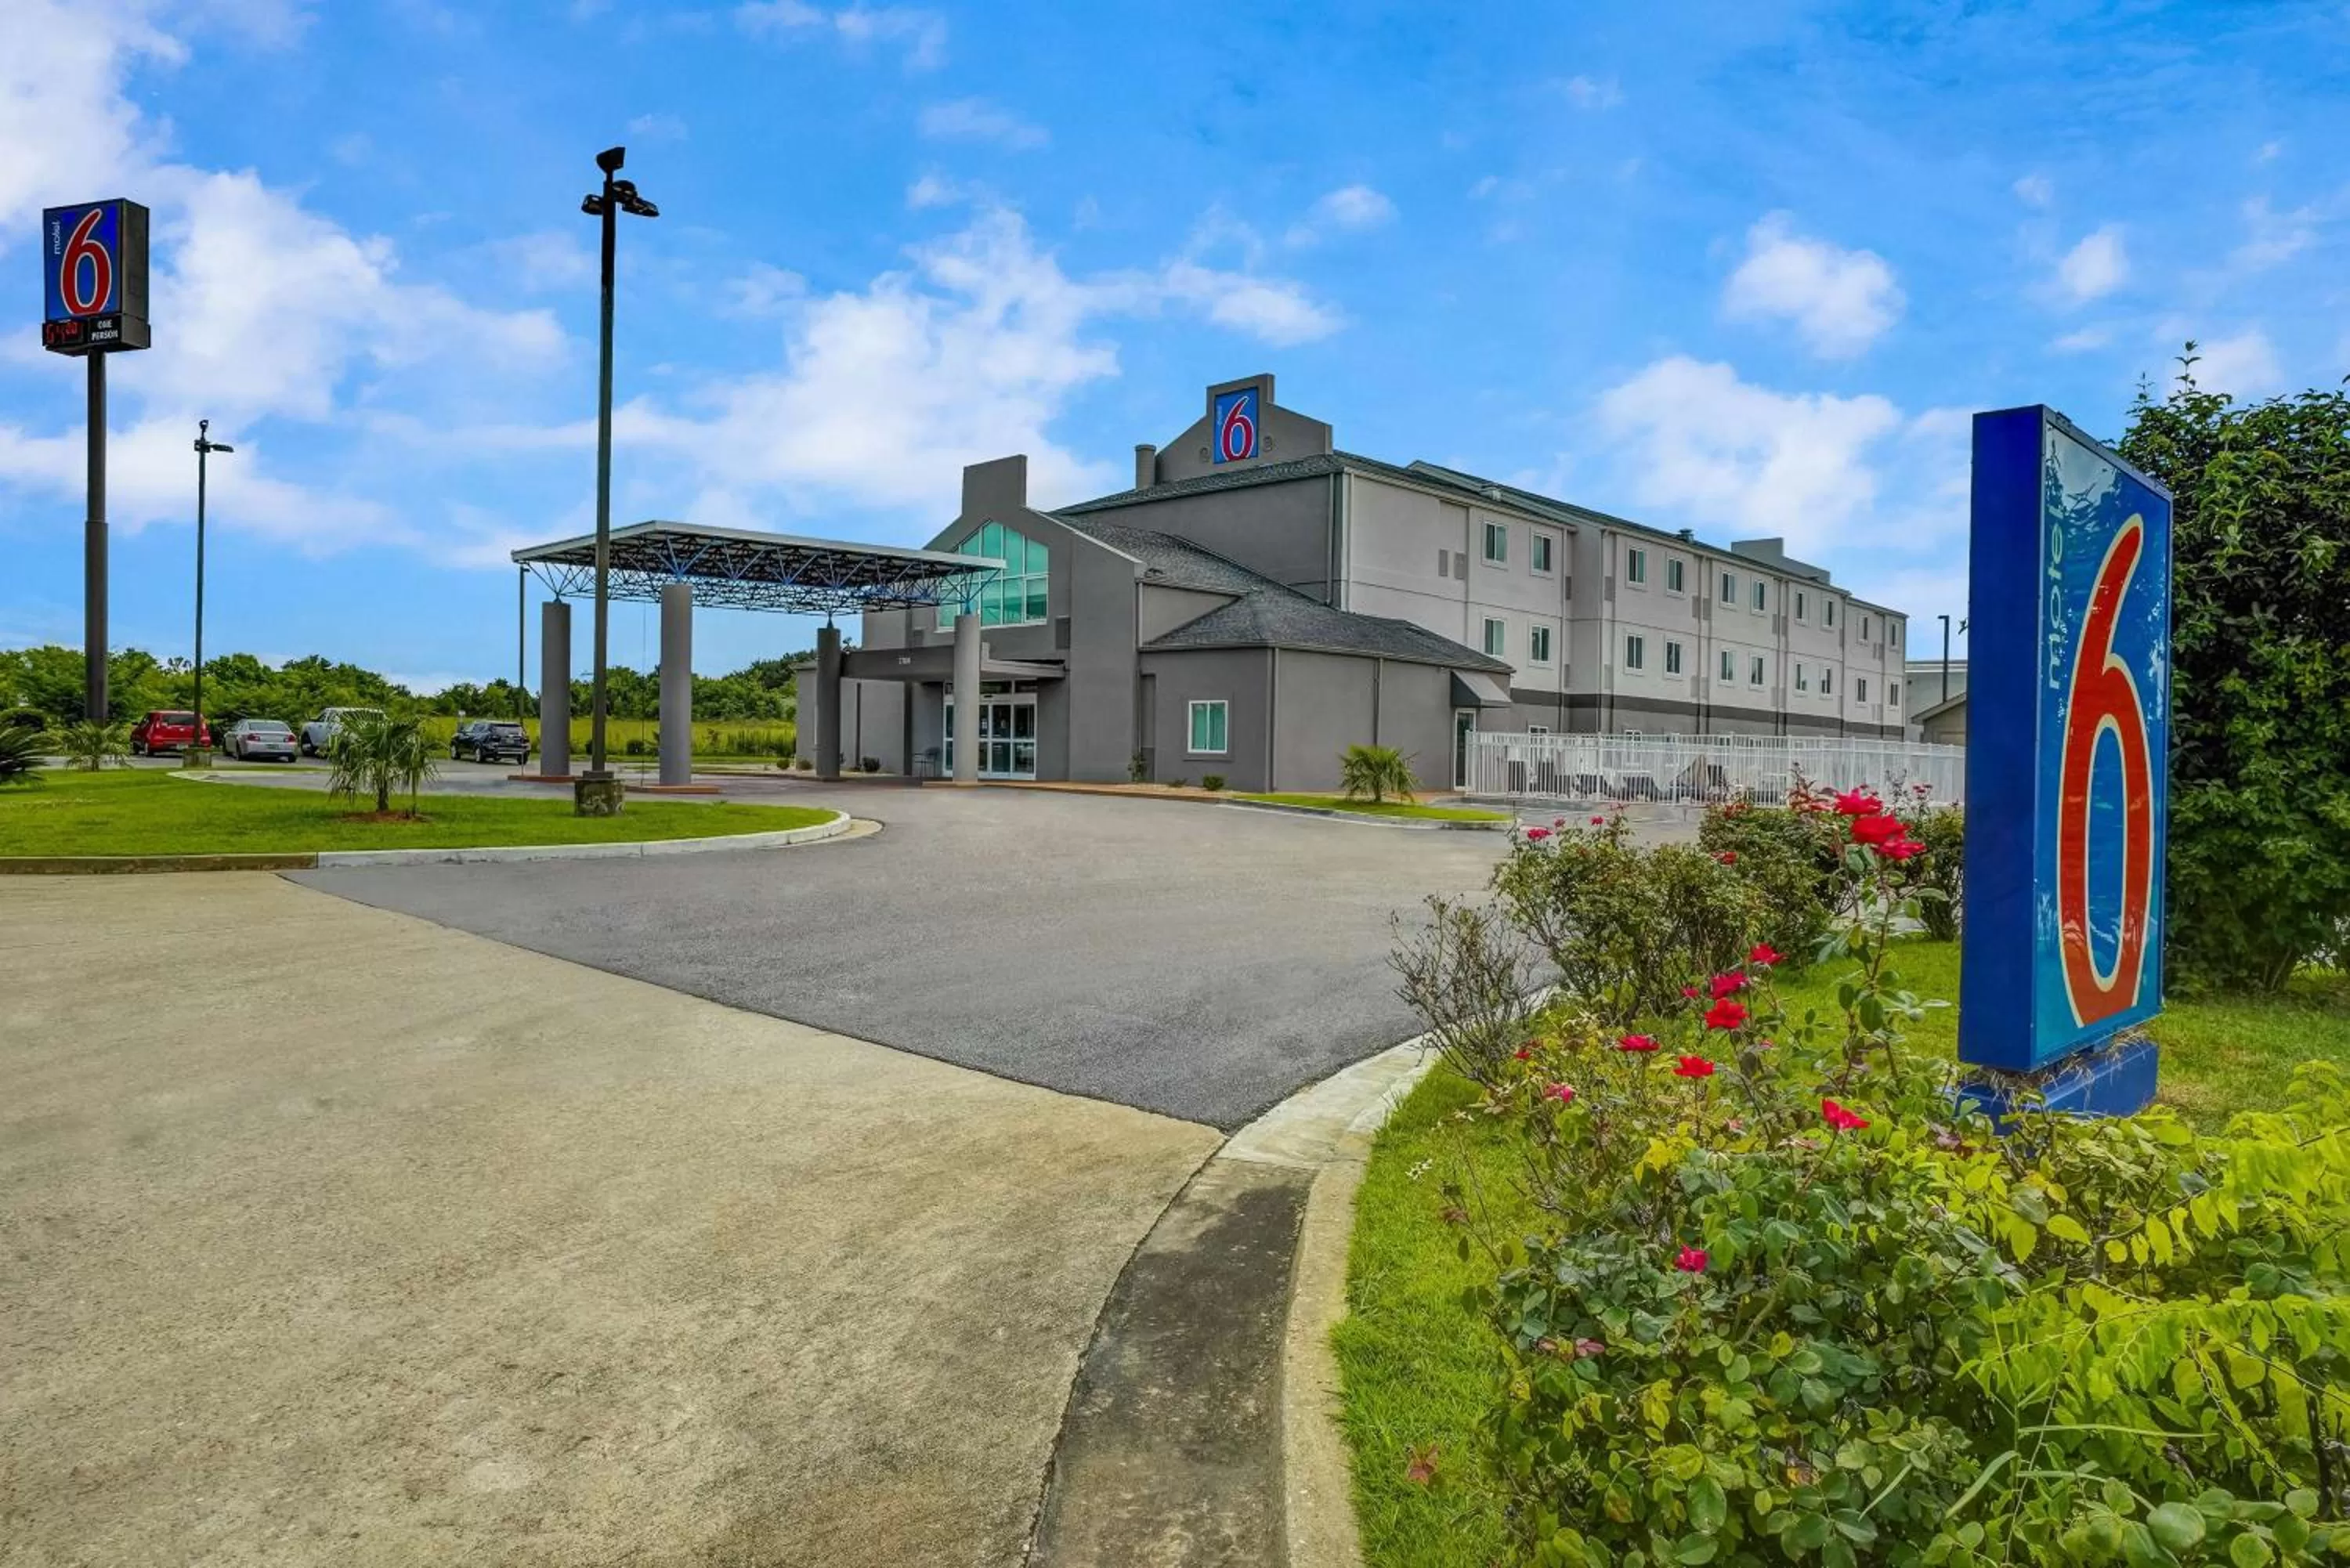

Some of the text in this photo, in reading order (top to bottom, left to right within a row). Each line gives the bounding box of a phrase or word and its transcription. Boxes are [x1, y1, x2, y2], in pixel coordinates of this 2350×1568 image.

[60, 208, 112, 316] 6
[91, 330, 118, 341] PERSON
[1221, 396, 1254, 461] 6
[2047, 504, 2155, 1029] motel 6
